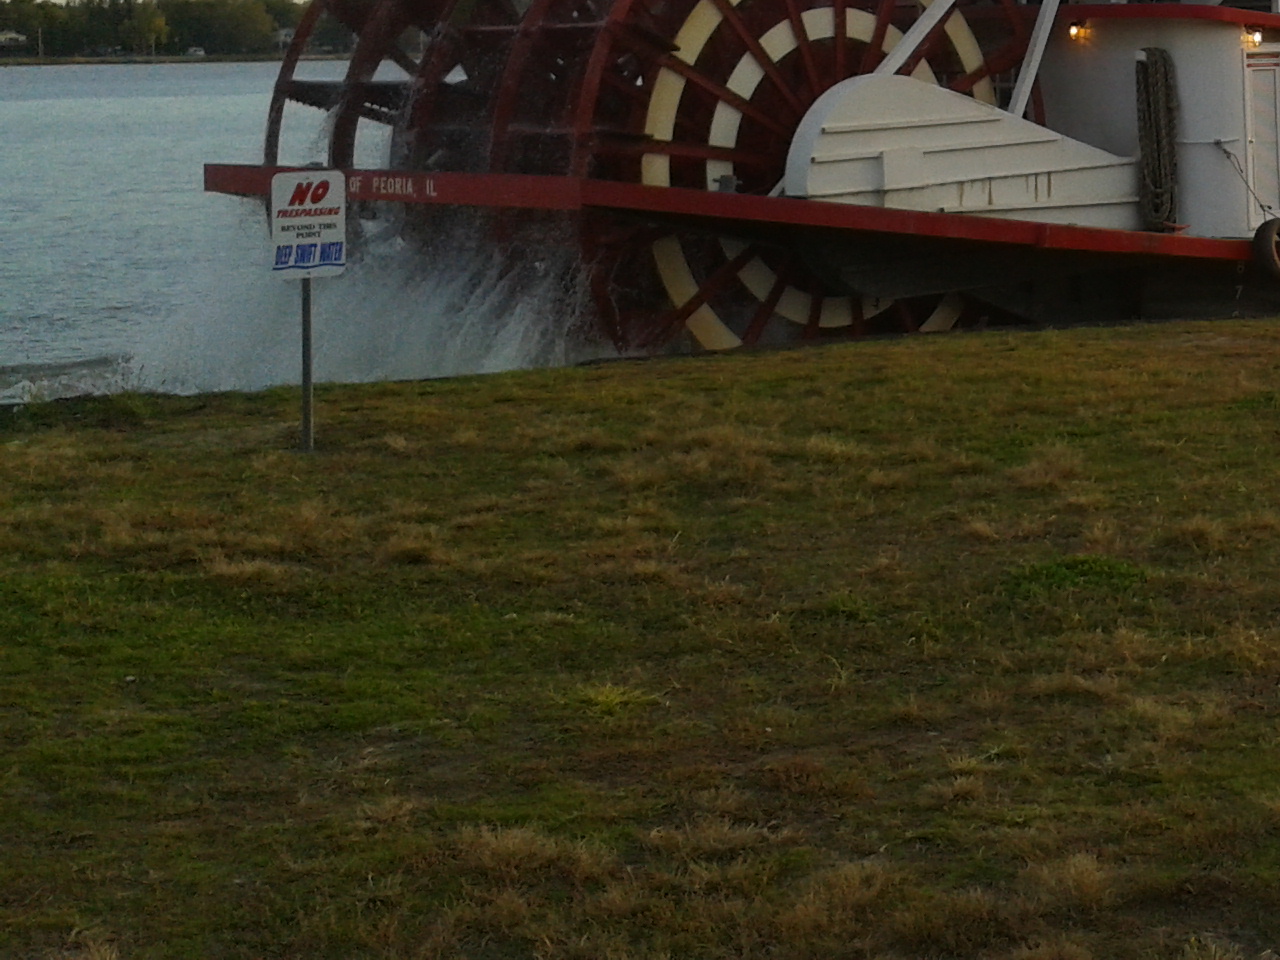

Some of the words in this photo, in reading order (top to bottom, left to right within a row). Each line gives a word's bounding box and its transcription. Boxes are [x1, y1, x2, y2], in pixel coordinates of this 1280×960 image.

[288, 180, 330, 207] NO
[349, 176, 362, 193] OF
[426, 178, 438, 196] IL
[276, 206, 341, 218] TRESPASSING
